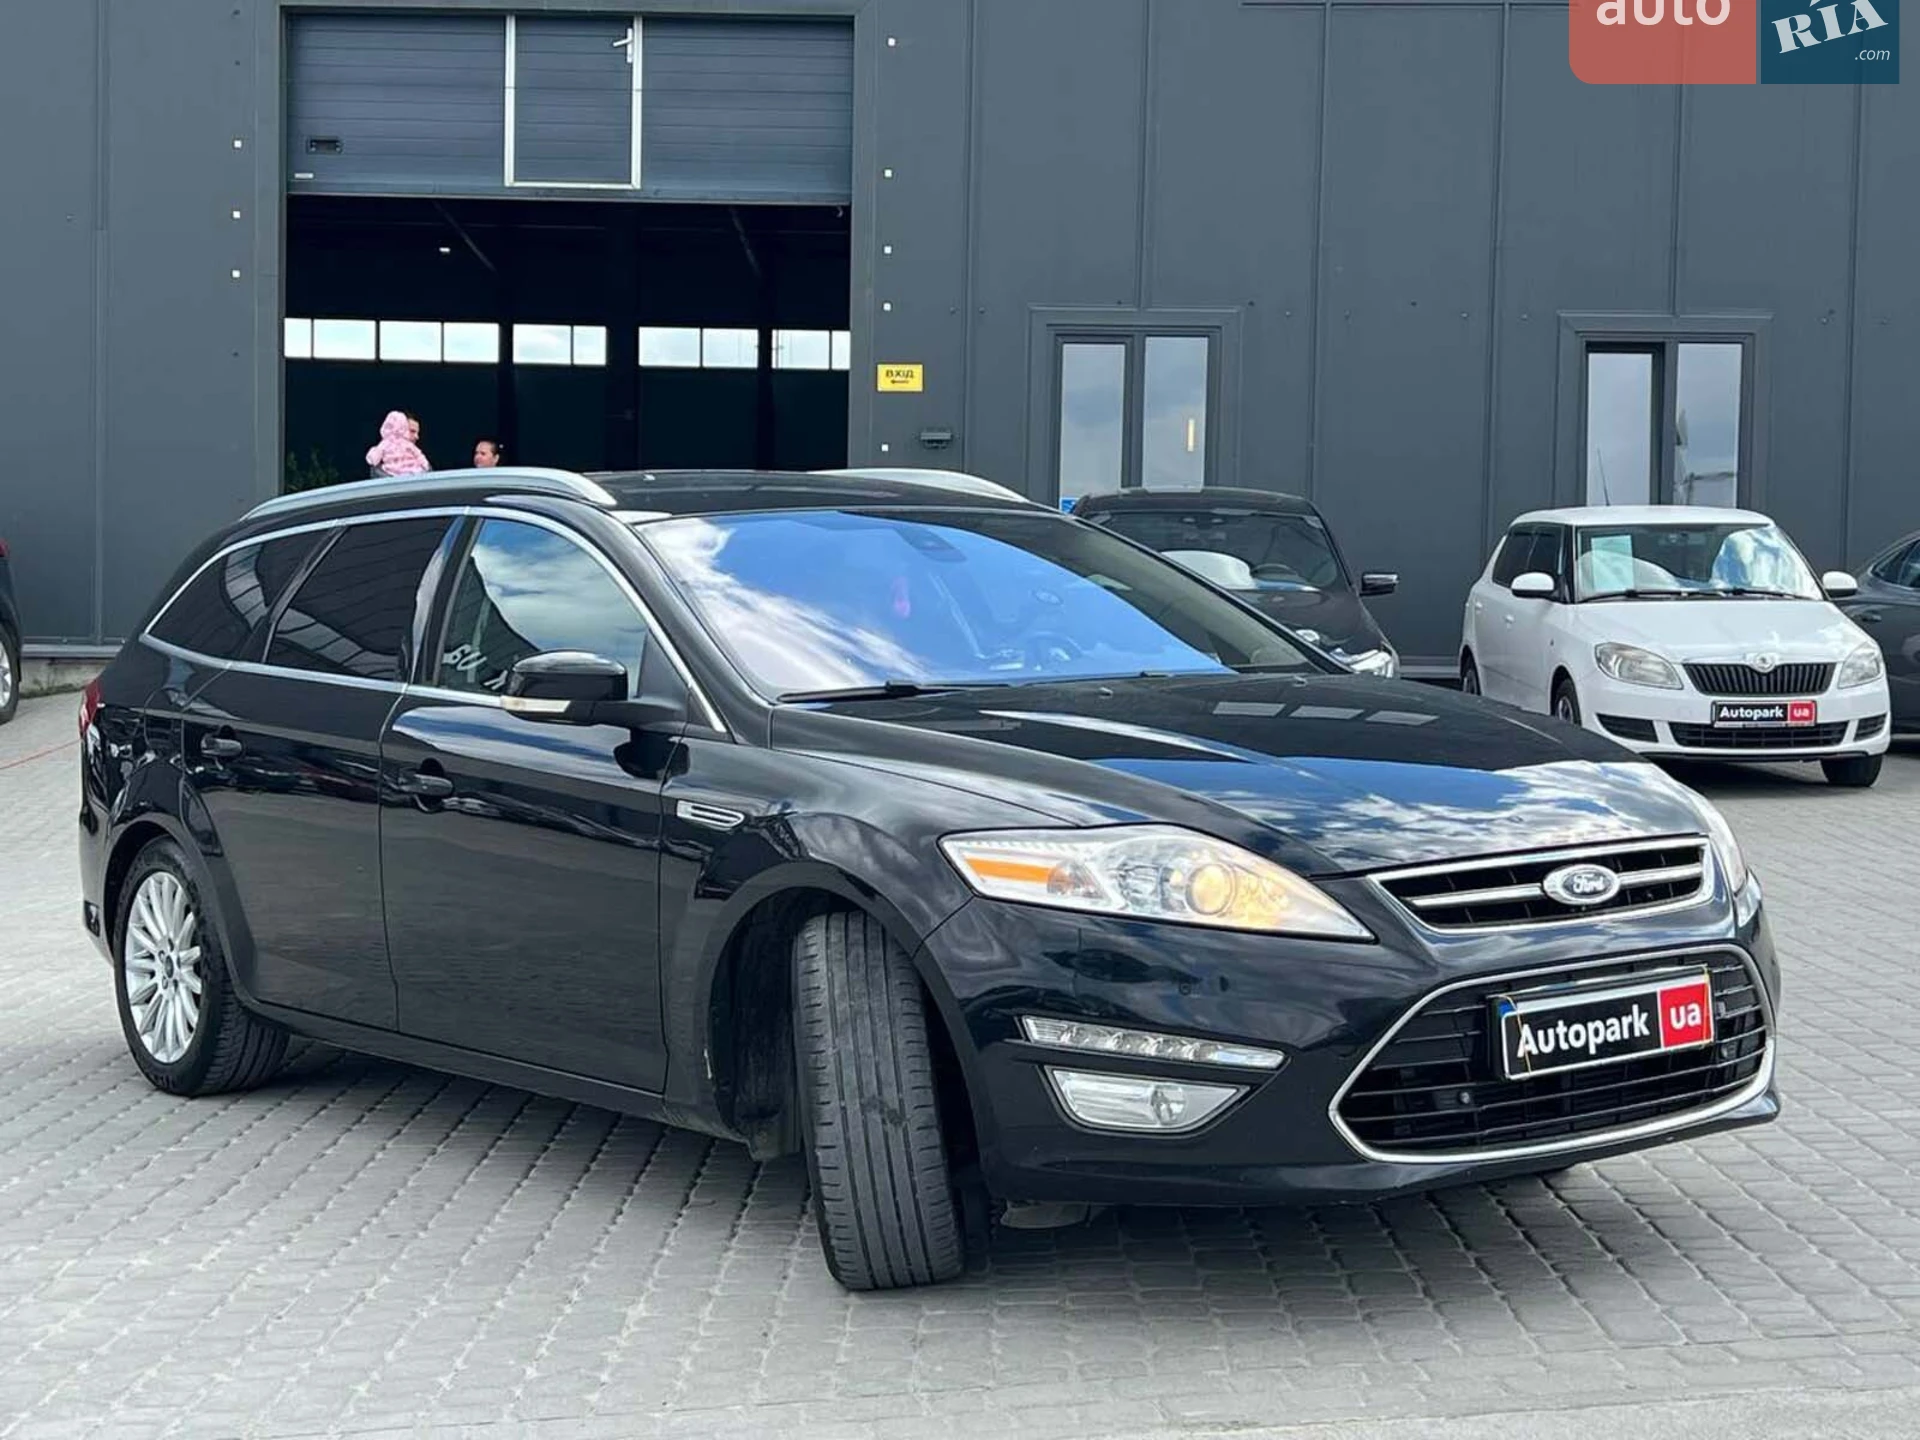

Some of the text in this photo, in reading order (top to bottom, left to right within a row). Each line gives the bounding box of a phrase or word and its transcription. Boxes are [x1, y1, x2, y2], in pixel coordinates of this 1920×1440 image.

[1720, 706, 1810, 720] Autopark ua
[1573, 873, 1605, 893] Ford
[1516, 1002, 1702, 1058] Autopark ua
